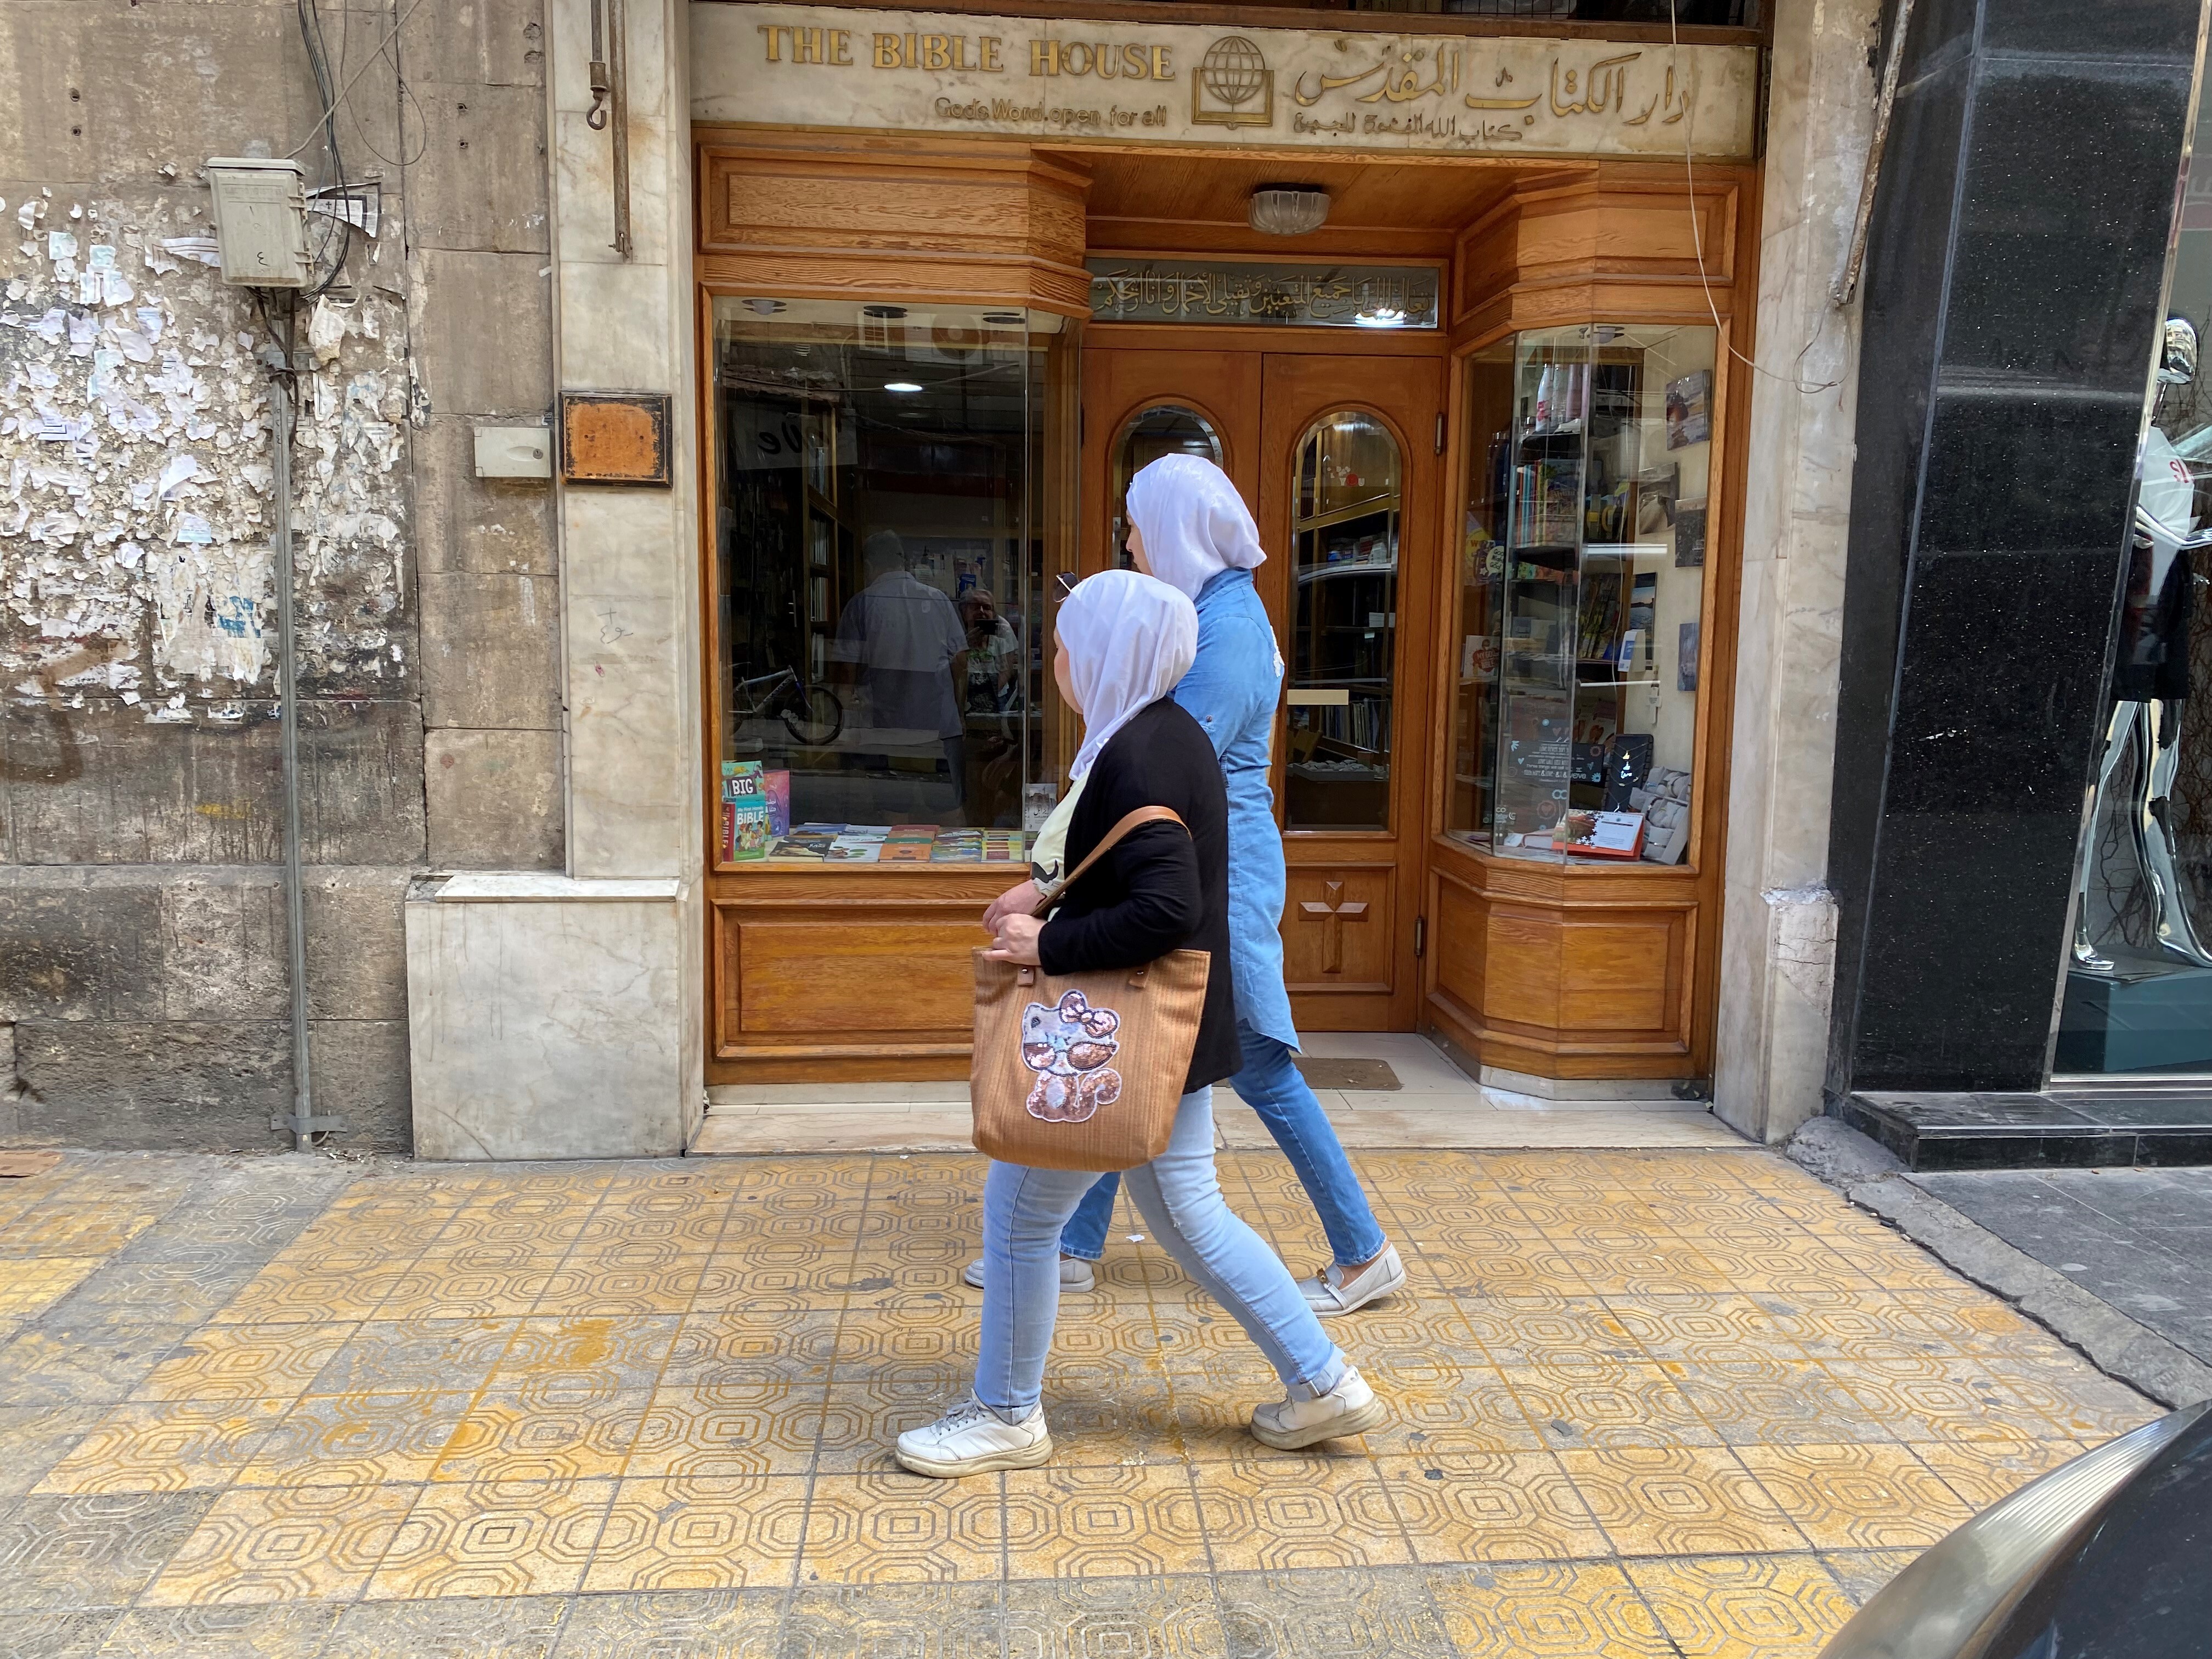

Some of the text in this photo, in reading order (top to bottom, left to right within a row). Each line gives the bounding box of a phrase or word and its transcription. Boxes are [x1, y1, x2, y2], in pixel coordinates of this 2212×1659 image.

[757, 25, 1176, 82] THE BIBLE HOUSE
[1465, 51, 1643, 125] الكتاب
[1622, 65, 1689, 125] دار
[934, 97, 989, 120] God's
[1049, 107, 1102, 128] open
[1109, 104, 1138, 126] for
[1142, 104, 1167, 127] all
[1293, 111, 1523, 145] كتاب الله المفتوح للجميع
[731, 778, 753, 795] BIG
[737, 810, 764, 825] BIBLE
